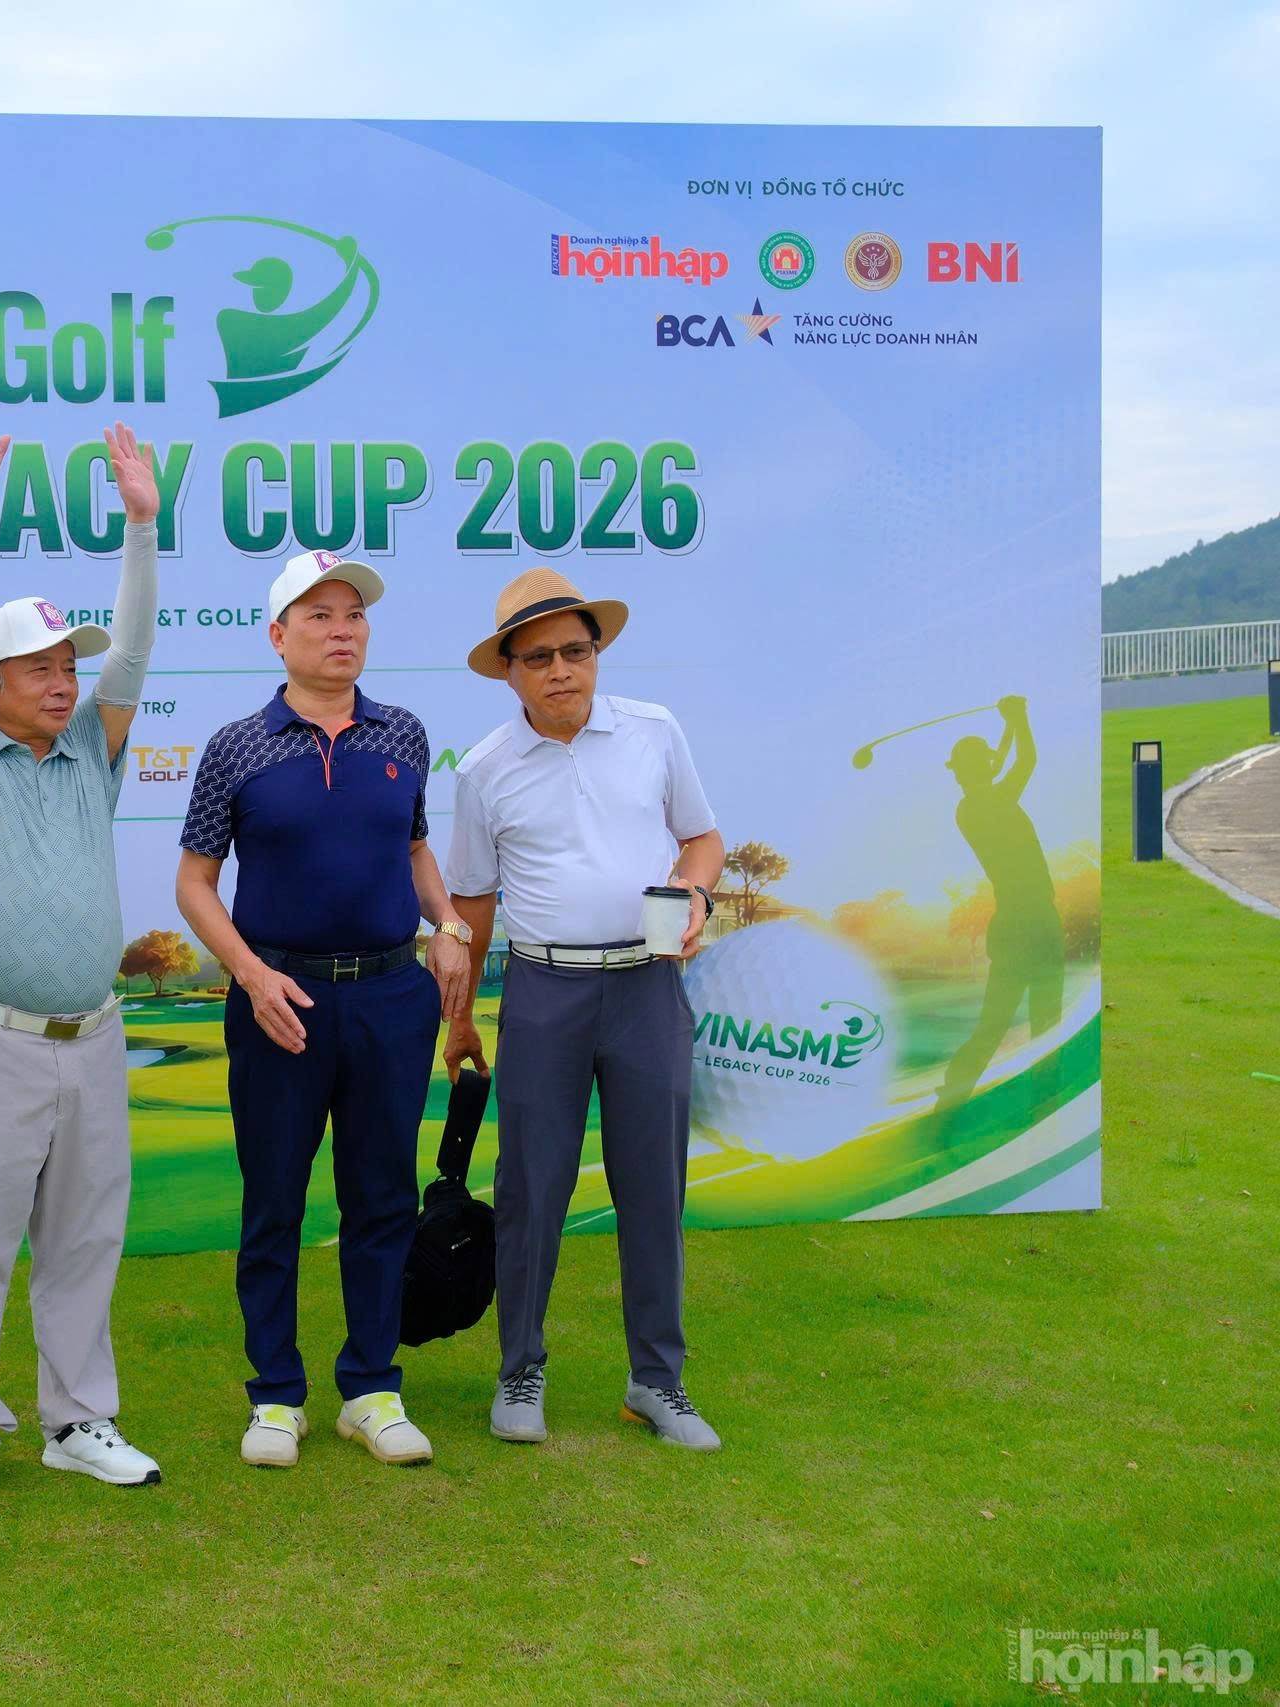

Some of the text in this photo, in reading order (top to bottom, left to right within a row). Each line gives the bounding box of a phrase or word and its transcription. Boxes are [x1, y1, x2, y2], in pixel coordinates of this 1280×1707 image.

[687, 177, 905, 199] ĐƠN VỊ ĐỒNG TỔ CHỨC
[570, 236, 649, 247] Doanh nghiệp &
[927, 242, 1019, 283] BNI
[793, 312, 893, 327] TĂNG CƯỜNG
[656, 313, 736, 347] BCA
[794, 331, 978, 347] NĂNG LỰC DOANH NHÂN
[222, 440, 430, 556] CUP
[454, 439, 701, 555] 2026
[157, 608, 187, 627] &T
[196, 608, 263, 627] GOLF
[141, 700, 176, 718] TRỢ
[130, 746, 196, 769] T&T
[139, 770, 188, 782] GOLF
[704, 1055, 831, 1086] LEGACY CUP 2026
